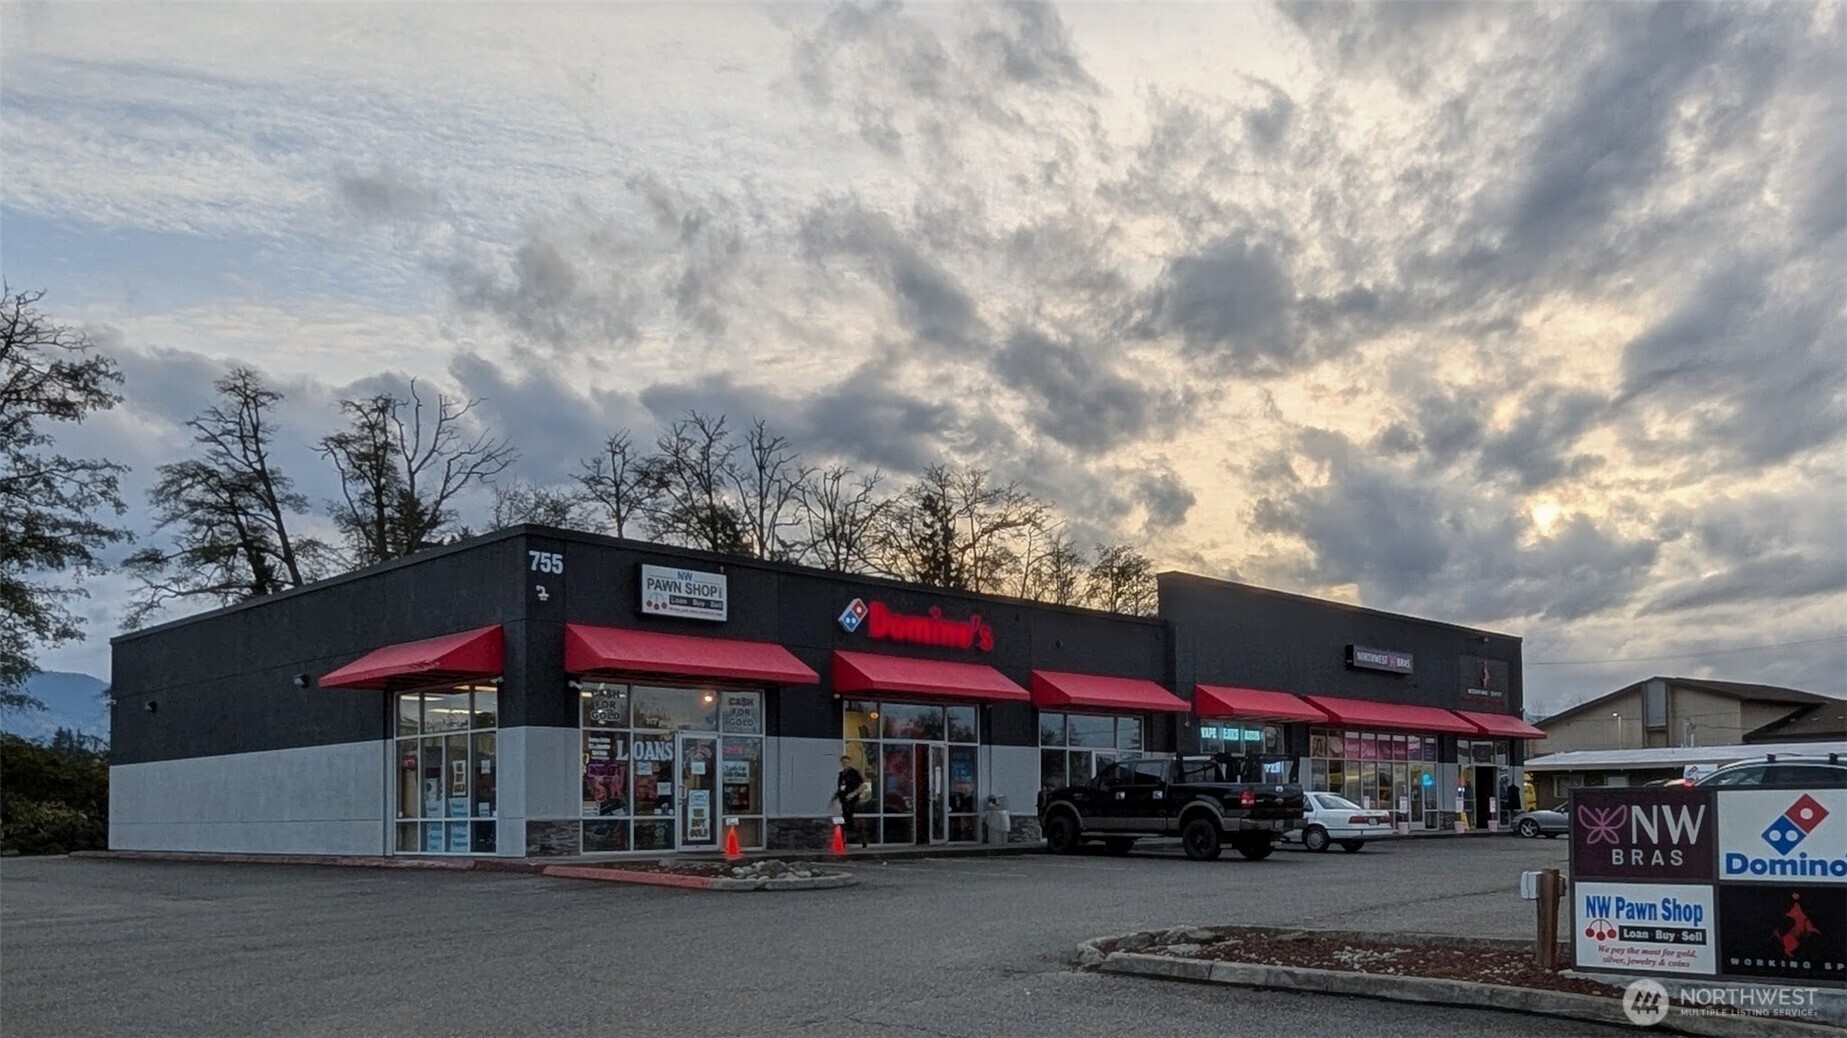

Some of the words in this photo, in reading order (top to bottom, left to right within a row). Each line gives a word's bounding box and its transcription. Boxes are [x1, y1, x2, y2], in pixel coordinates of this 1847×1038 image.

[529, 550, 564, 574] 755
[677, 571, 693, 581] NW
[647, 578, 682, 593] PAWN
[685, 582, 717, 597] SHOP
[868, 601, 994, 651] Domino's
[596, 700, 616, 709] FOR
[732, 708, 751, 717] FOR
[616, 740, 674, 761] LOANS
[1631, 804, 1706, 845] NW
[1612, 849, 1683, 866] BRAS
[1725, 852, 1847, 877] Domino
[1586, 895, 1611, 919] NW
[1615, 896, 1657, 920] Pawn
[1661, 897, 1703, 927] Shop
[1623, 928, 1649, 939] Loan
[1655, 929, 1675, 942] Buy
[1681, 931, 1703, 942] Sell
[1598, 945, 1610, 953] We
[1610, 947, 1625, 955] pay
[1627, 946, 1640, 954] the
[1661, 948, 1675, 957] for
[1627, 957, 1656, 967] jewelry
[1658, 958, 1666, 966] &
[1730, 957, 1811, 969] WORKING
